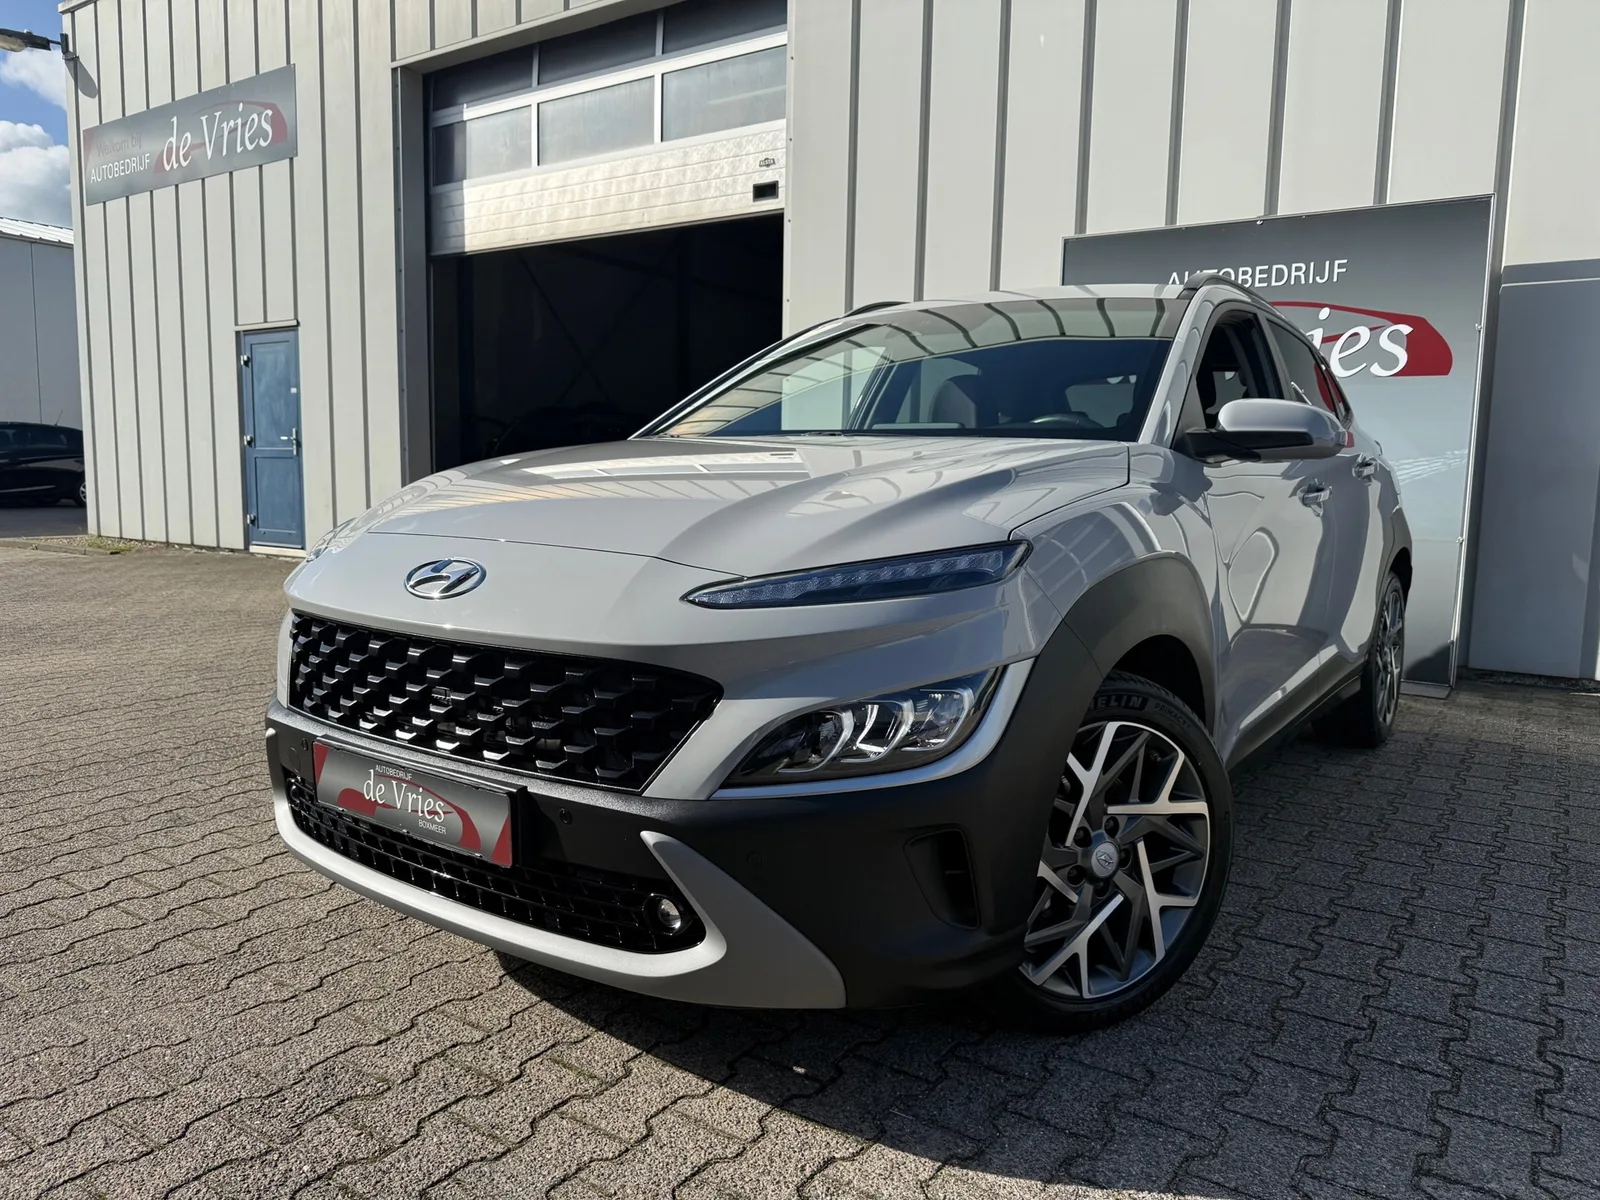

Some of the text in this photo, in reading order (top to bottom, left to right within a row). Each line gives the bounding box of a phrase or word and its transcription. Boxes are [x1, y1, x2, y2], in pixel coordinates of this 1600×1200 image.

[162, 102, 274, 172] de Vries
[90, 153, 150, 184] AUTOBEDRIJF
[1168, 259, 1349, 288] AOBEDRIJF
[1306, 307, 1414, 378] ies
[1154, 702, 1187, 726] PRIMACY
[375, 764, 413, 781] AUTOBEDRIJF
[363, 769, 445, 823] de Vries
[418, 819, 447, 835] BOXMEER
